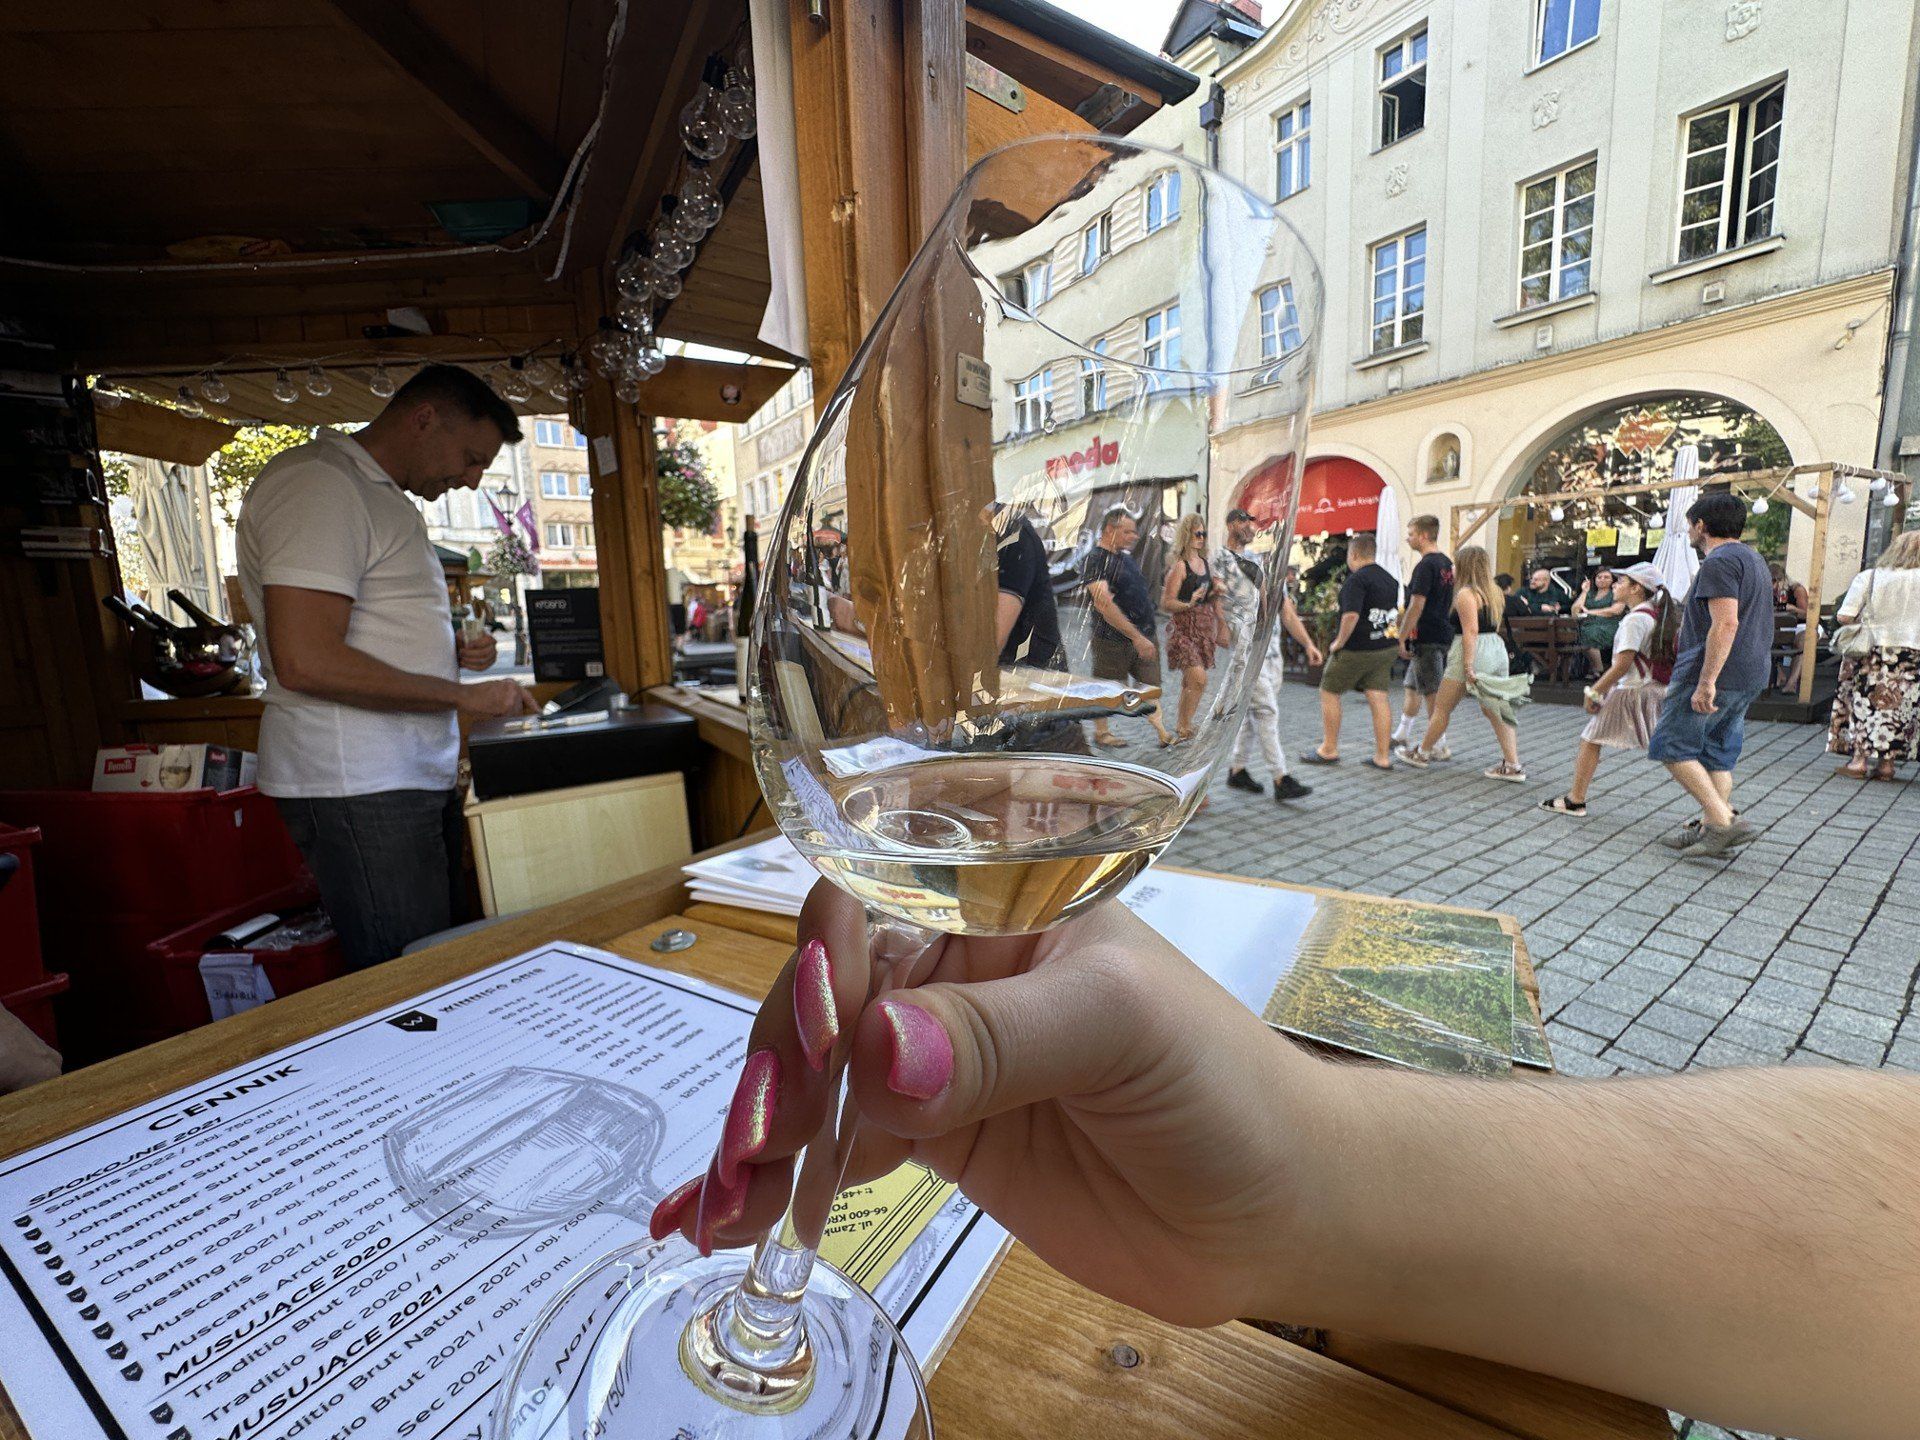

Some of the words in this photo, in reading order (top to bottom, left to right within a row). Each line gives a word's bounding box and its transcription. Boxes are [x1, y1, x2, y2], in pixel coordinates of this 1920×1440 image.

[29, 1140, 168, 1205] SPOKOJNE
[173, 1116, 222, 1142] 2021
[44, 1176, 121, 1214] Solaris
[128, 1151, 177, 1178] 2022
[224, 1117, 255, 1132] 750
[255, 1109, 274, 1118] ml
[55, 1166, 175, 1227] Johanniter
[180, 1132, 251, 1170] Orange
[254, 1114, 293, 1135] 2021
[333, 1084, 359, 1098] 750
[360, 1076, 375, 1085] ml
[65, 1178, 187, 1241] Johanniter
[192, 1160, 226, 1179] Sur
[231, 1145, 260, 1162] Lie
[264, 1125, 303, 1146] 2021
[342, 1094, 369, 1109] 750
[370, 1086, 386, 1095] ml
[76, 1191, 199, 1255] Johanniter
[204, 1173, 240, 1191] Sur
[243, 1156, 273, 1173] Lie
[276, 1135, 316, 1156] 2021
[358, 1102, 382, 1118] 750
[383, 1094, 400, 1104] ml
[88, 1203, 214, 1270] Johanniter
[218, 1184, 254, 1204] Sur
[257, 1166, 287, 1184] Lie
[290, 1128, 365, 1167] Barrique
[367, 1109, 402, 1129] 2021
[437, 1080, 460, 1093] 750
[461, 1072, 476, 1081] ml
[113, 1254, 197, 1303] Solaris
[202, 1223, 258, 1256] 2022
[306, 1180, 337, 1198] 750
[340, 1169, 358, 1180] ml
[591, 1031, 614, 1043] PLN
[148, 1064, 303, 1131] CENNIK
[100, 1209, 242, 1286] Chardonnay
[248, 1180, 296, 1210] 2022
[340, 1143, 369, 1160] 750
[371, 1133, 389, 1145] ml
[125, 1265, 227, 1322] Riesling
[229, 1233, 279, 1265] 2021
[328, 1190, 359, 1209] 750
[362, 1177, 381, 1190] ml
[607, 1038, 630, 1051] PLN
[141, 1274, 252, 1341] Muscaris
[257, 1243, 306, 1274] 2021
[354, 1198, 385, 1215] 750
[388, 1185, 406, 1198] ml
[624, 1044, 647, 1059] PLN
[156, 1291, 269, 1361] Muscaris
[275, 1249, 339, 1291] Arctic
[341, 1220, 385, 1249] 2021
[429, 1178, 457, 1196] 375
[458, 1166, 475, 1179] ml
[641, 1052, 665, 1067] PLN
[184, 1335, 287, 1400] Traditio
[291, 1297, 344, 1333] Brut
[346, 1261, 398, 1297] 2020
[444, 1213, 474, 1232] 750
[476, 1200, 494, 1214] ml
[660, 1079, 680, 1091] 120
[679, 1064, 703, 1079] PLN
[202, 1353, 306, 1423] Traditio
[310, 1320, 356, 1351] Sec
[359, 1281, 412, 1319] 2020
[459, 1229, 489, 1250] 750
[491, 1216, 509, 1231] ml
[680, 1086, 700, 1099] 120
[698, 1071, 721, 1087] PLN
[842, 1188, 863, 1199] +48
[849, 1206, 888, 1219] 66-600
[857, 1219, 873, 1231] ul.
[163, 1277, 326, 1386] MUSUJĄCE
[332, 1236, 392, 1279] 2020
[349, 1353, 402, 1391] Brut
[403, 1294, 476, 1349] Nature
[479, 1260, 521, 1295] 2021
[559, 1212, 587, 1233] 750
[588, 1200, 605, 1214] ml
[370, 1369, 425, 1413] Brut
[427, 1329, 476, 1369] 2021
[520, 1271, 551, 1295] 750
[553, 1255, 572, 1271] ml
[387, 1283, 442, 1329] 2021
[397, 1398, 445, 1438] Sec
[447, 1354, 497, 1397] 2021
